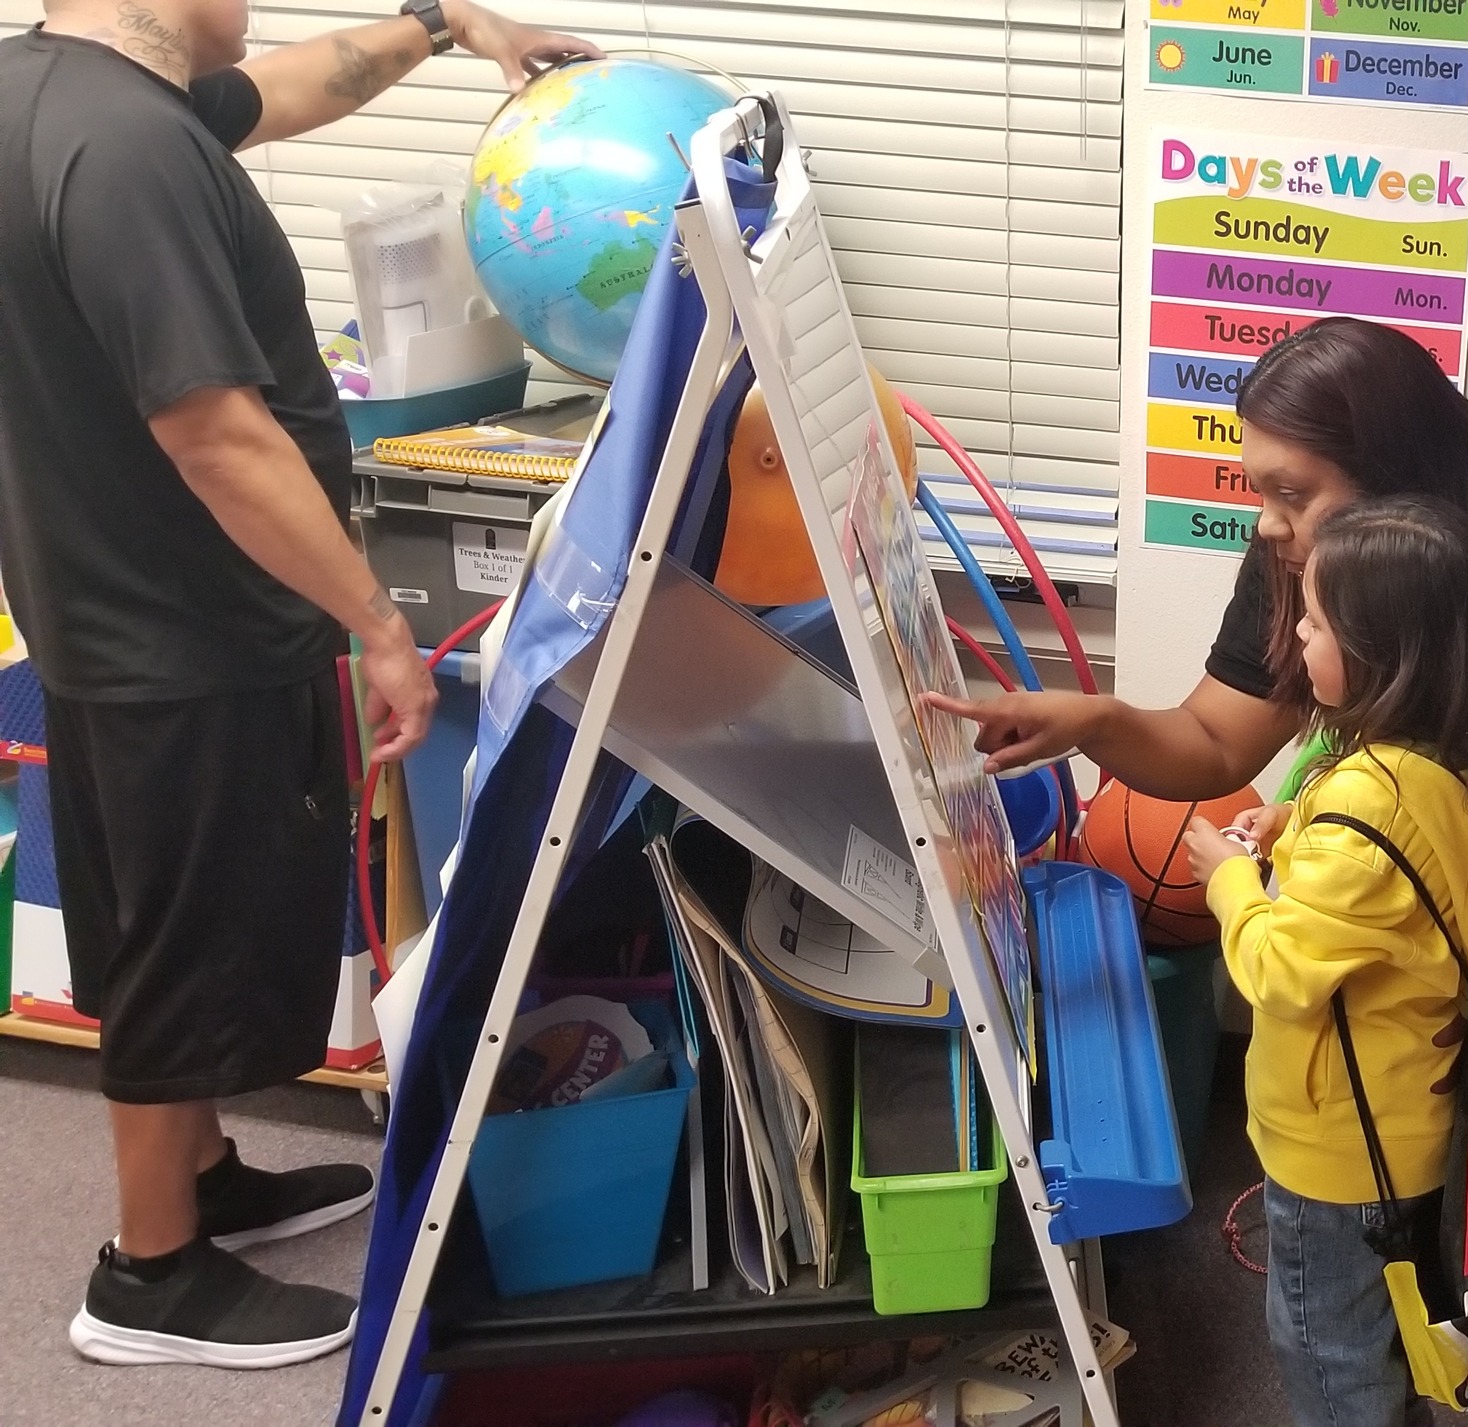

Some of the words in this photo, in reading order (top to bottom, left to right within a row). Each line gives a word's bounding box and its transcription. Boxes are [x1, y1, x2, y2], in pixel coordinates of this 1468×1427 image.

[1228, 6, 1259, 24] May
[1389, 17, 1420, 32] Nov.
[1213, 40, 1273, 66] June
[1345, 50, 1463, 80] December
[1226, 70, 1256, 85] Jun.
[1386, 82, 1418, 97] Dec.
[1161, 139, 1284, 199] Days
[1294, 157, 1318, 173] of
[1287, 177, 1323, 195] the
[1324, 154, 1466, 206] Week
[1214, 211, 1330, 254] Sunday
[1402, 235, 1448, 257] Sun.
[1206, 263, 1333, 306] Monday
[1394, 288, 1448, 311] Mon.
[1205, 315, 1294, 346] Tuesd
[1176, 363, 1247, 394] Wed
[459, 548, 481, 557] Trees
[474, 560, 489, 570] Box
[498, 564, 506, 572] of
[480, 572, 508, 583] Kinder
[551, 1034, 609, 1106] CENTER
